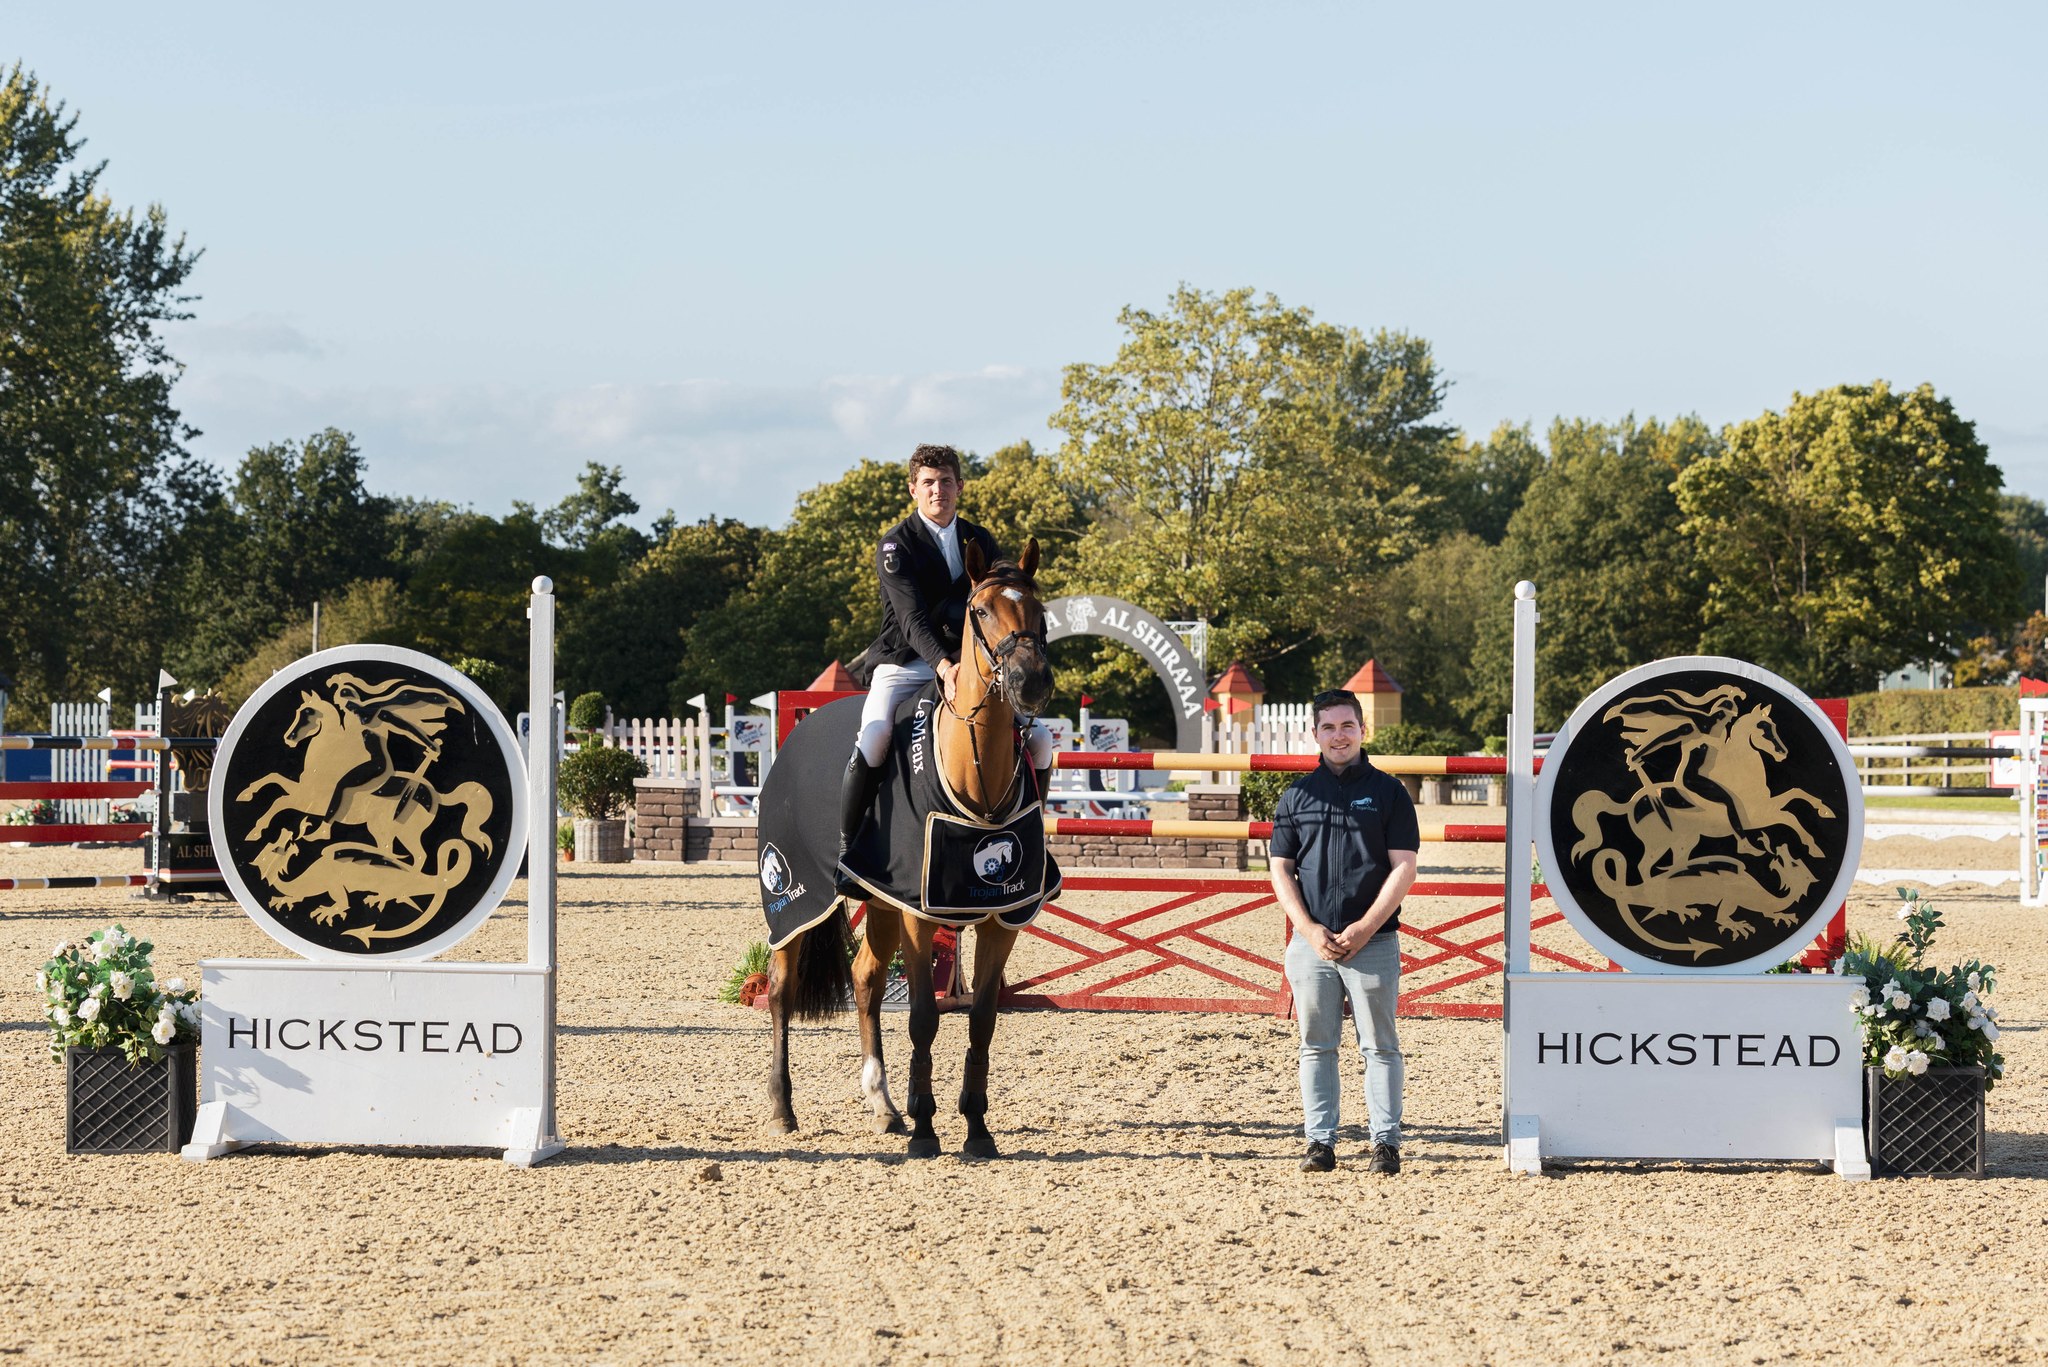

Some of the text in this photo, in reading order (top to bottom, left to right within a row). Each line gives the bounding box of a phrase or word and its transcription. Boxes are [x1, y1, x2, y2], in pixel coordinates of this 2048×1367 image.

[1100, 607, 1202, 720] AL SHIRA'AA
[912, 697, 935, 775] LeMieux
[176, 845, 193, 858] AL
[228, 1017, 523, 1054] HICKSTEAD
[1537, 1032, 1841, 1067] HICKSTEAD
